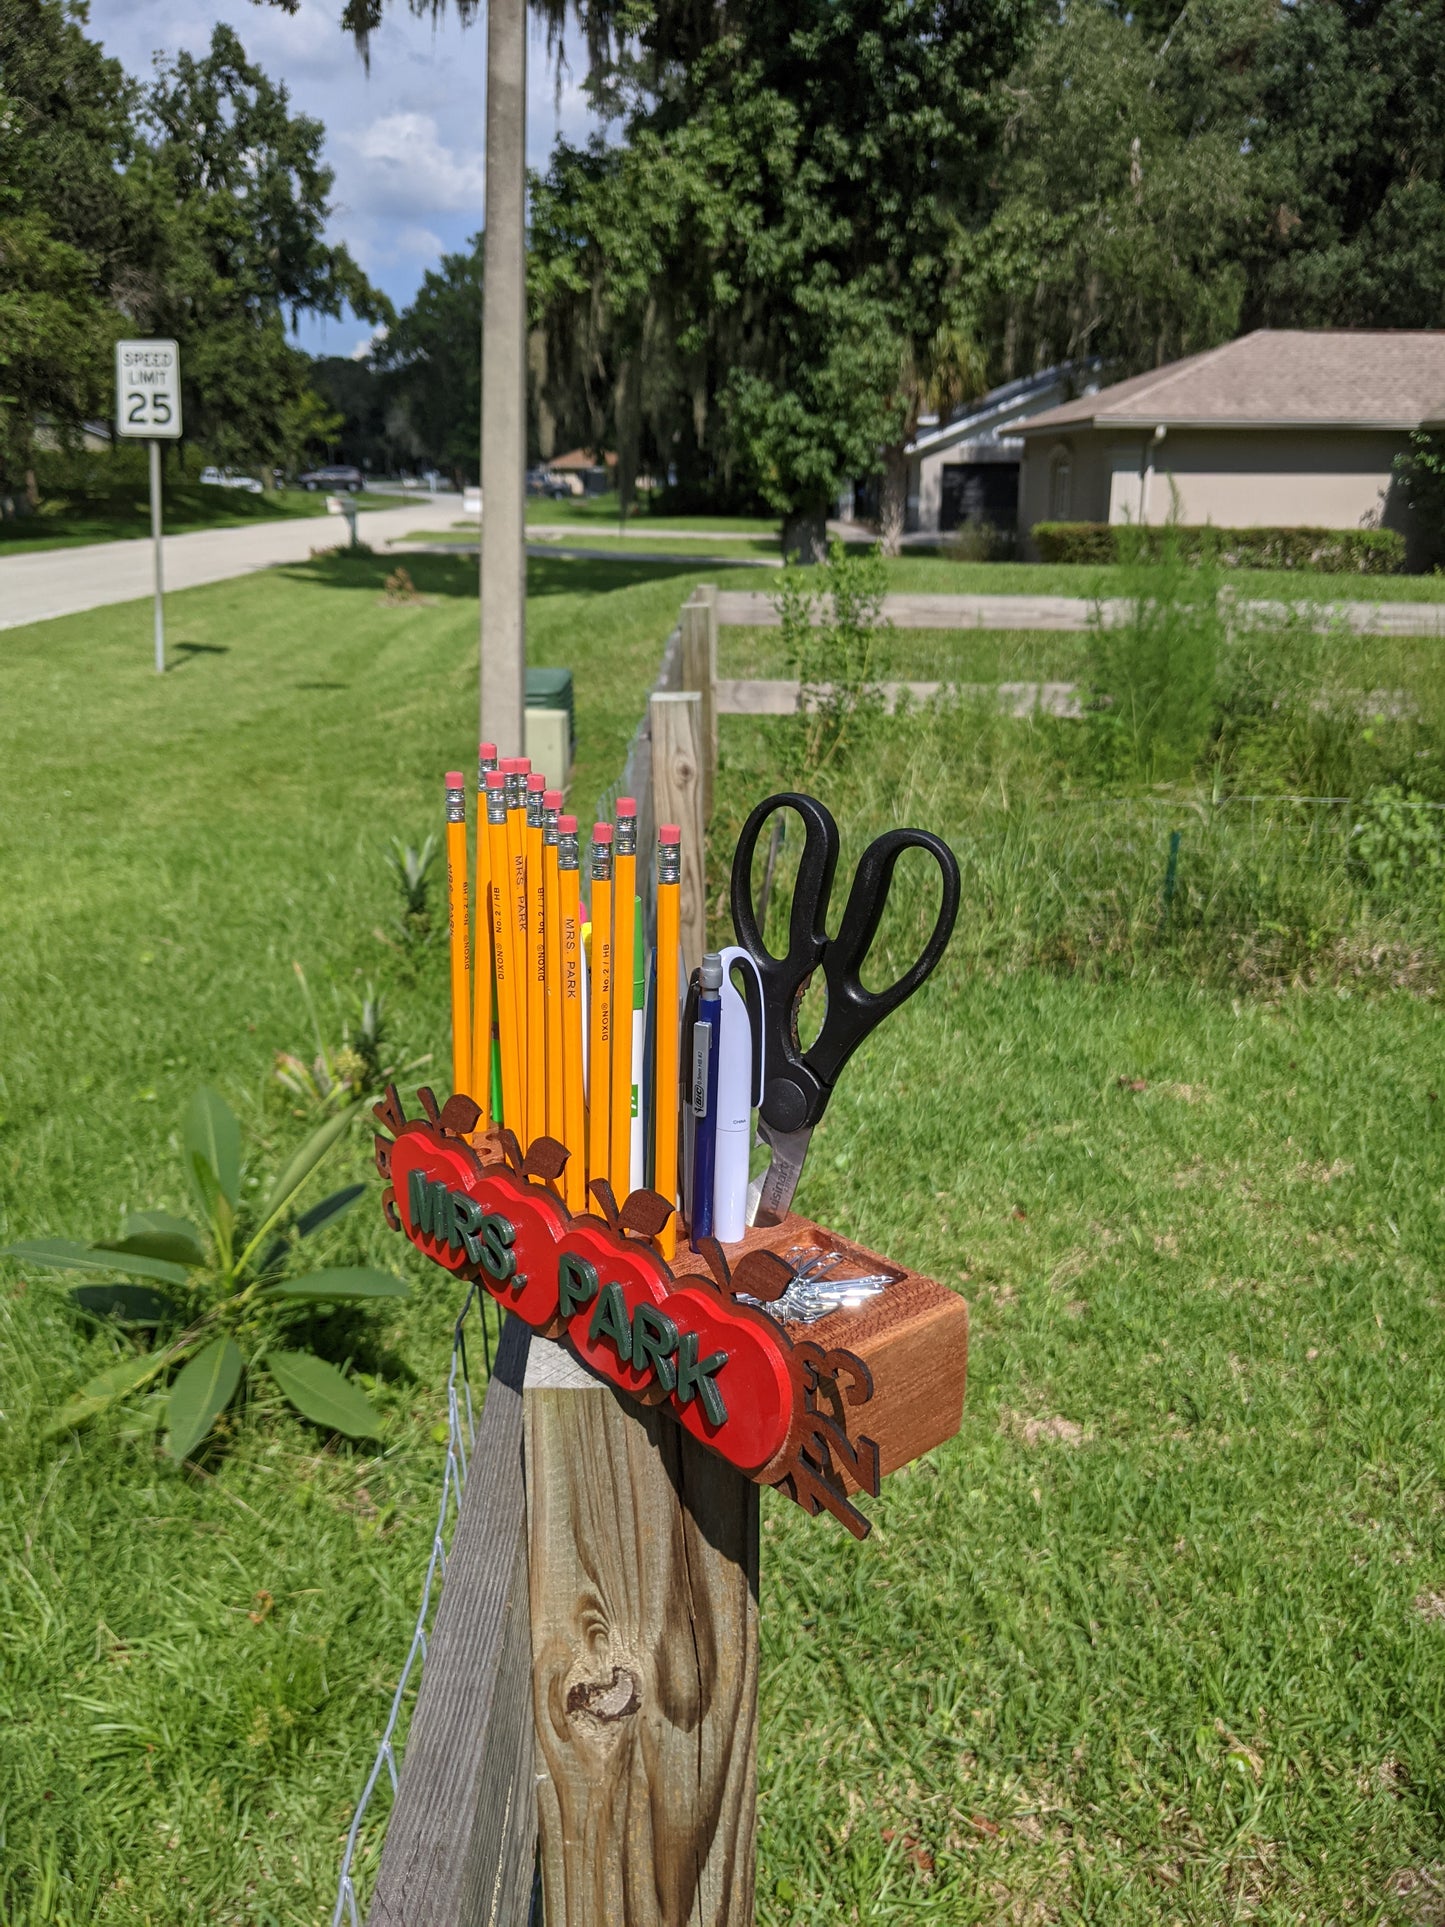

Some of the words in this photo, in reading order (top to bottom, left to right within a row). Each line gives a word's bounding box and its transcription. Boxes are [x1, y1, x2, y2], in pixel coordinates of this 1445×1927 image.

[122, 351, 173, 367] SPEED
[128, 370, 168, 385] LIMIT
[127, 392, 172, 425] 25
[515, 855, 524, 890] MRS.
[493, 887, 500, 900] HB
[517, 895, 527, 932] PARK
[565, 918, 576, 954] MRS.
[602, 944, 610, 957] HB
[566, 961, 576, 999] PARK
[695, 1086, 704, 1106] BIC
[407, 1167, 528, 1290] MRS.
[558, 1251, 729, 1427] PARK
